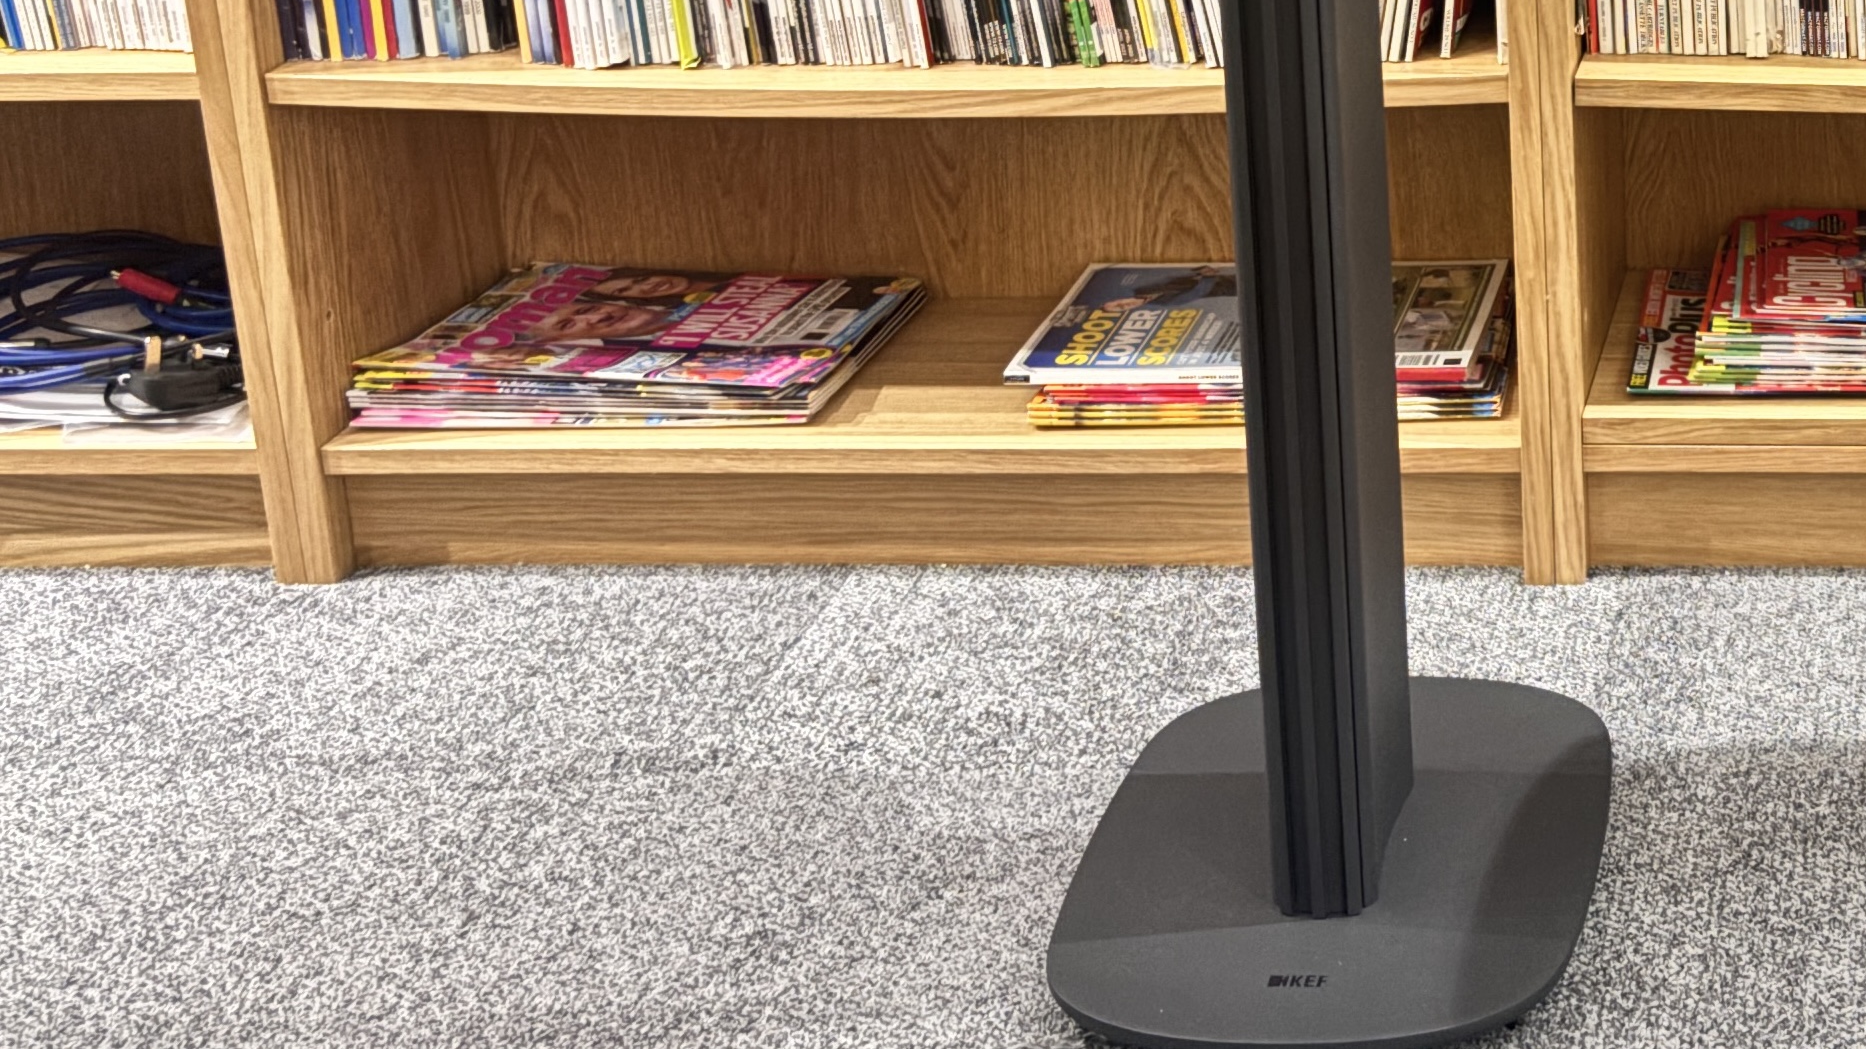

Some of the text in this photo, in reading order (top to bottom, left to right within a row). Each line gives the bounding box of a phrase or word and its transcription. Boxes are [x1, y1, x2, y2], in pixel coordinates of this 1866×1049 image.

[671, 307, 740, 333] WILL
[711, 276, 783, 305] STEAL
[1055, 310, 1122, 366] SHOOT
[1096, 310, 1162, 366] LOWER
[1136, 309, 1199, 366] SCORES
[1289, 975, 1329, 987] KEF
